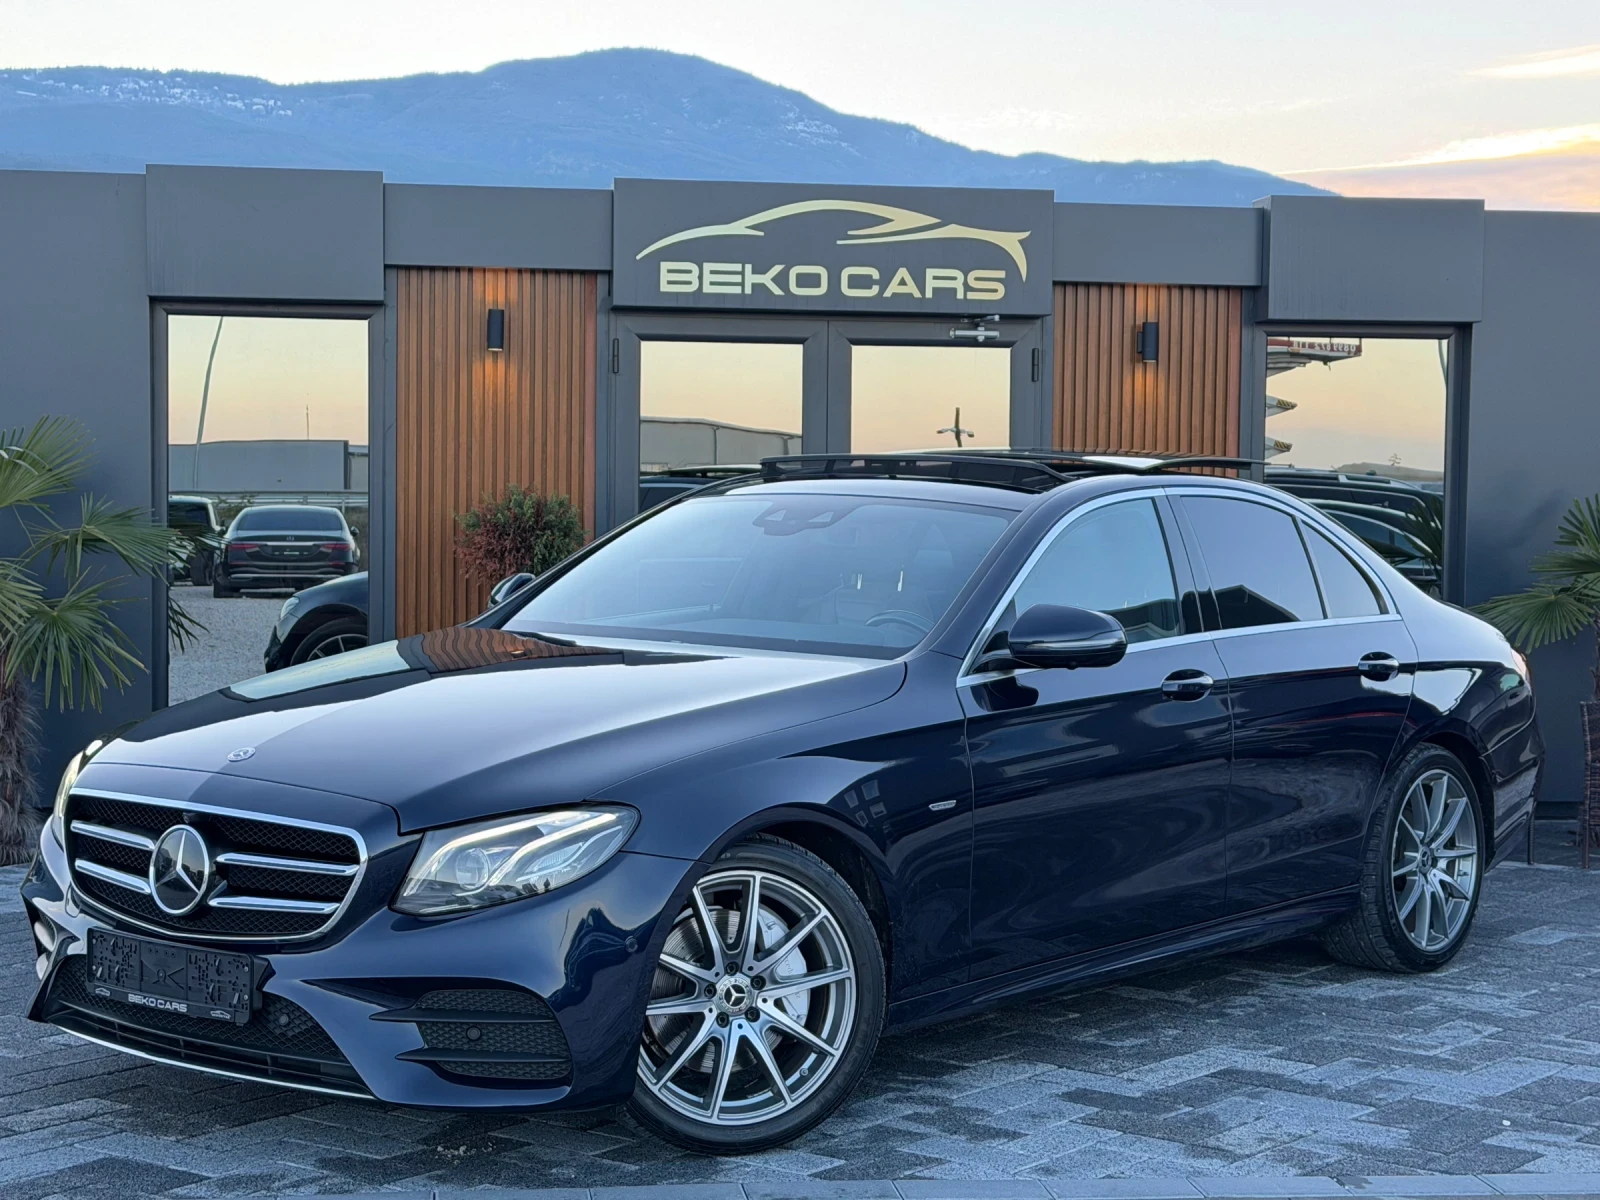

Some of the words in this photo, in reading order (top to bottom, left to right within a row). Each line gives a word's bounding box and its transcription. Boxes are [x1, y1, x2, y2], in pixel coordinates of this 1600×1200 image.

[659, 261, 828, 295] BEKO
[840, 266, 1005, 300] CARS
[128, 993, 156, 1007] BEKO
[157, 999, 188, 1012] CARS
